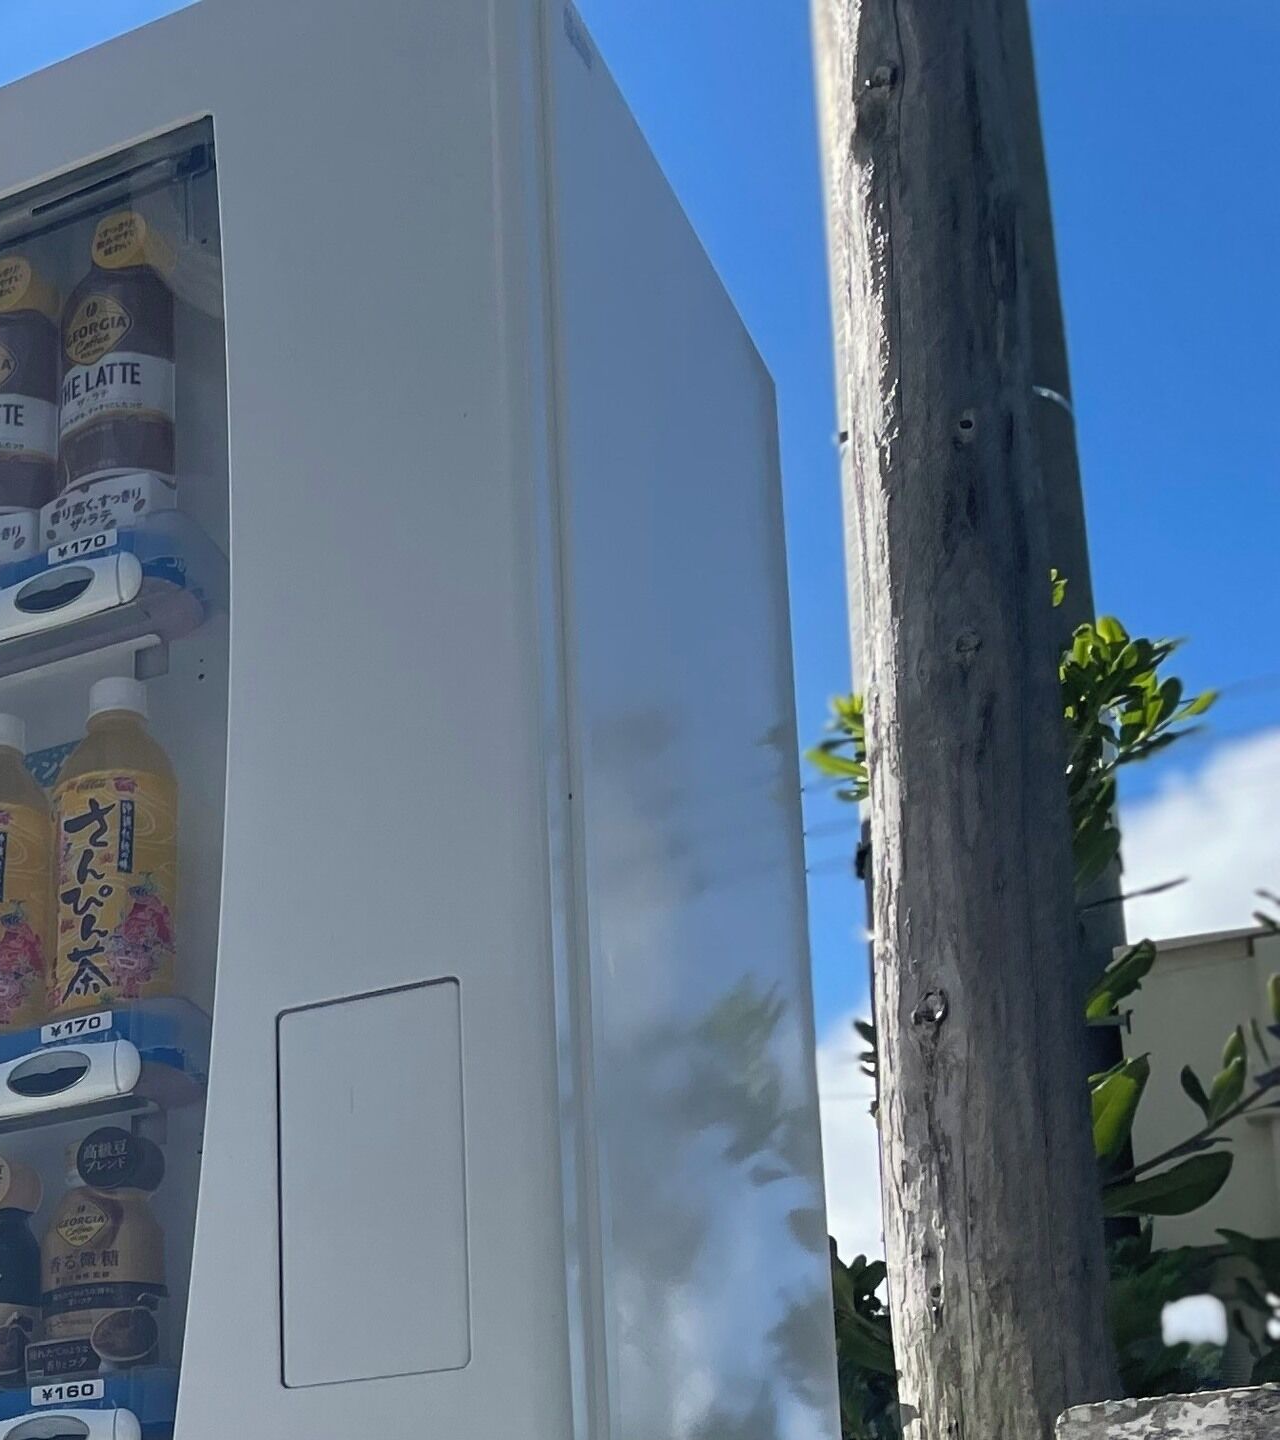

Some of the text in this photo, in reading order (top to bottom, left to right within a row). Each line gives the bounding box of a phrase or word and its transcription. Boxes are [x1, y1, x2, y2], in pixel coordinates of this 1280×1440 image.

[85, 362, 142, 391] LATTE
[50, 487, 142, 526] 香り高く、すっきり
[70, 508, 112, 531] ザ・ラテ
[58, 535, 106, 557] ¥170
[61, 797, 117, 1004] さんぴん茶
[51, 1017, 100, 1037] ¥170
[83, 1138, 128, 1160] 高級豆
[84, 1156, 128, 1174] ブレンド
[49, 1250, 120, 1275] 香る微糖
[43, 1384, 93, 1400] ¥160
